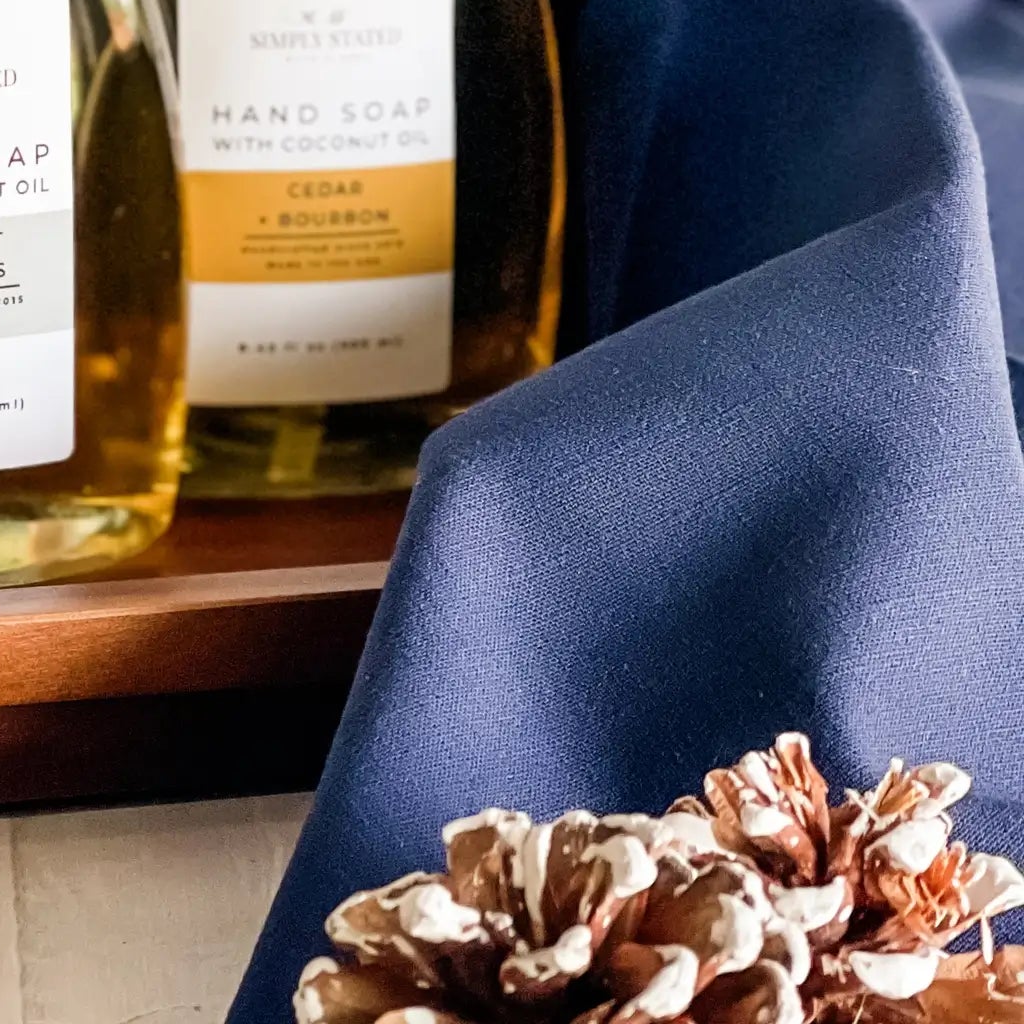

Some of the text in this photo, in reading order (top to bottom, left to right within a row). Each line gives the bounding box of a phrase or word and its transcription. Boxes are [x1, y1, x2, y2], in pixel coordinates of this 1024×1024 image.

[212, 97, 431, 125] HAND SOAP
[213, 130, 429, 154] WITH COCONUT OIL
[16, 177, 50, 195] OIL
[286, 180, 363, 200] CEDAR
[278, 208, 389, 227] BOURBON
